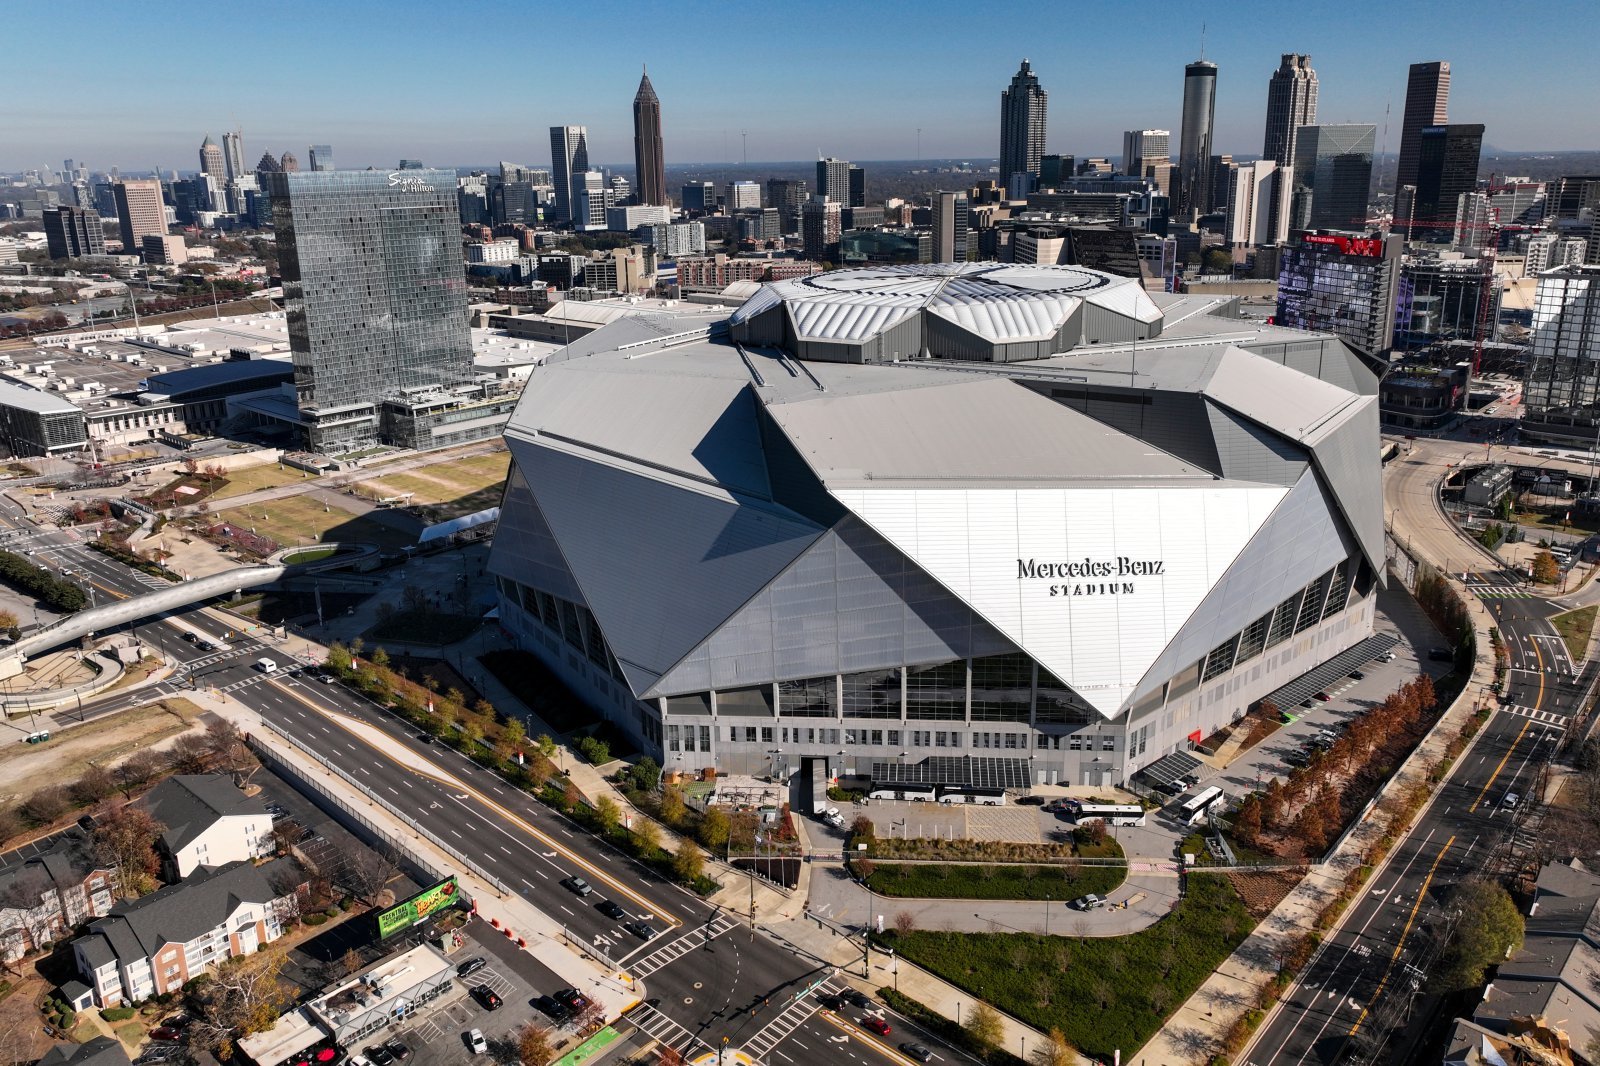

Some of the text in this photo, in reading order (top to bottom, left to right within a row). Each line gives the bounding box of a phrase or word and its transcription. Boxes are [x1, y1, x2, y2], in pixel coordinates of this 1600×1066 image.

[388, 172, 425, 192] Signia
[411, 184, 434, 192] Hilton
[1016, 556, 1166, 579] Mercedes-Benz
[1049, 583, 1134, 597] STADIUM
